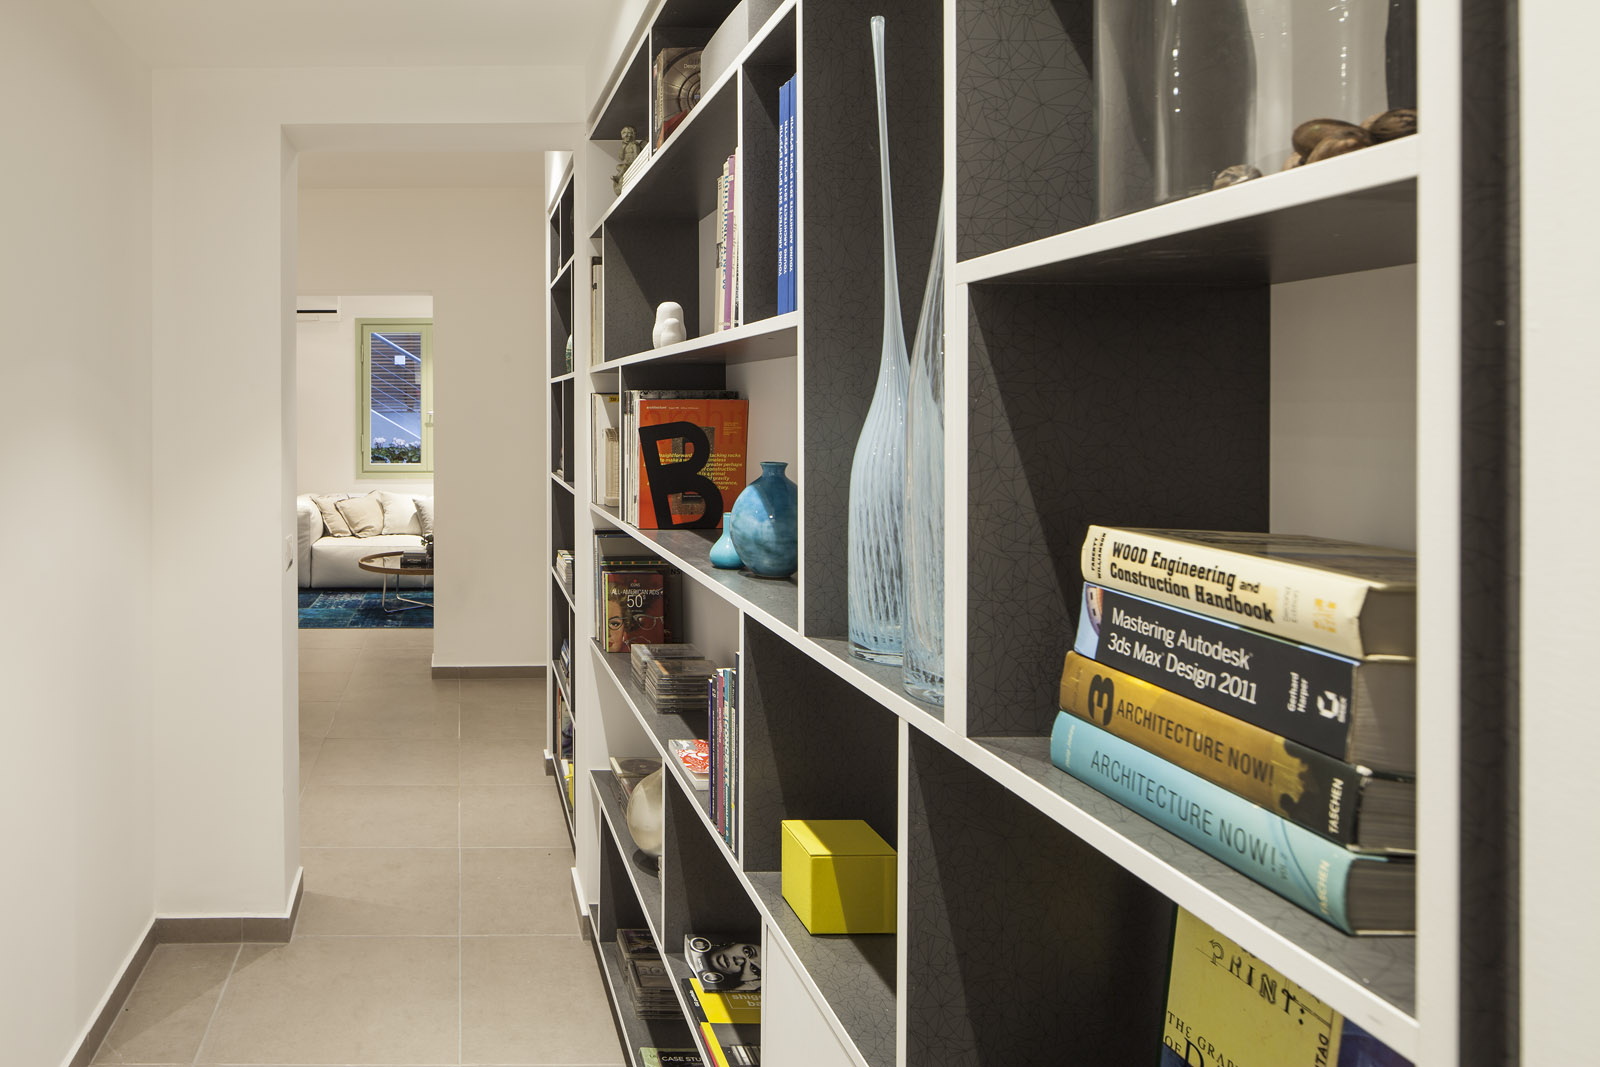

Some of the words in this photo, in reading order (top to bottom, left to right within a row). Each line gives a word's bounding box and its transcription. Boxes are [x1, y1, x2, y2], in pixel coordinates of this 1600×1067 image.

[638, 421, 724, 529] B
[1097, 532, 1107, 579] WILLIAMSON
[1112, 541, 1148, 564] WOOD
[1151, 551, 1236, 592] Engineering
[1239, 580, 1260, 593] and
[1110, 562, 1191, 599] Construction
[1195, 584, 1275, 624] Handbook
[1111, 607, 1176, 648] Mastering
[1177, 624, 1250, 670] Autodesk
[1107, 632, 1133, 657] 3ds
[1165, 653, 1218, 692] Design
[1218, 671, 1258, 705] 2011
[1287, 671, 1299, 712] Gerhard
[1297, 677, 1309, 713] Harper
[1088, 674, 1115, 726] 3
[1116, 699, 1225, 763] ARCHITECTURE
[1227, 747, 1275, 787] NOW!
[1090, 750, 1213, 836] ARCHITECTURE
[1219, 818, 1276, 873] NOW!
[1327, 777, 1345, 834] TASCHEN
[1317, 859, 1331, 915] TASCHEN
[1207, 939, 1306, 1026] PRINT:
[1167, 1010, 1193, 1039] THE
[1197, 1035, 1240, 1067] GRAP
